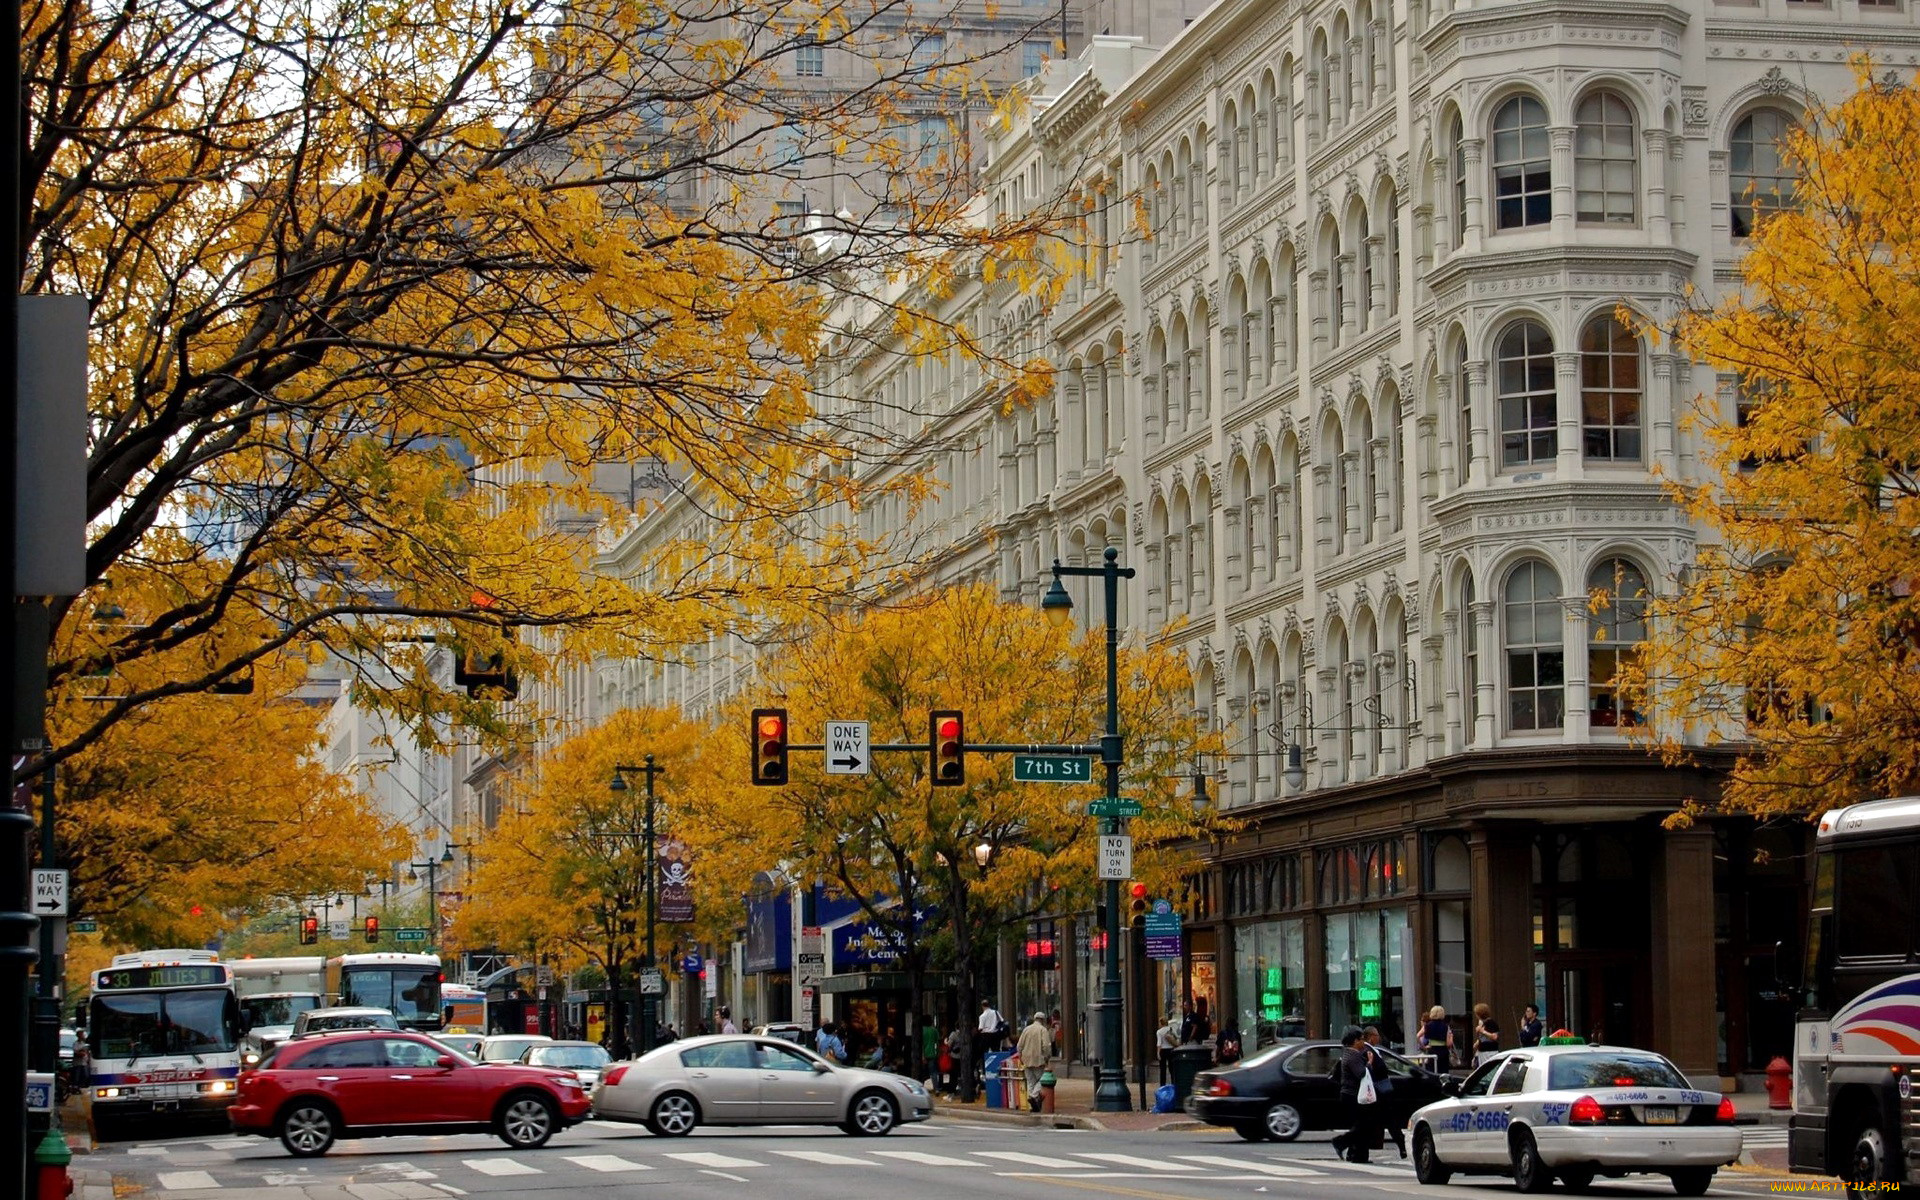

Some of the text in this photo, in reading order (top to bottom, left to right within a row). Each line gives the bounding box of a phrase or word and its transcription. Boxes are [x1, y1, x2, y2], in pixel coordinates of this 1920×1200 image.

[833, 725, 861, 738] ONE
[833, 740, 861, 752] WAY
[1024, 760, 1081, 775] 7th St
[1119, 808, 1140, 816] STREET
[1107, 839, 1122, 848] NO
[1105, 849, 1125, 857] TURN
[1107, 868, 1122, 876] RED
[38, 873, 62, 884] ONE
[37, 886, 62, 896] WAY
[867, 926, 905, 937] Meon
[868, 949, 907, 959] Cente
[113, 972, 130, 987] 33
